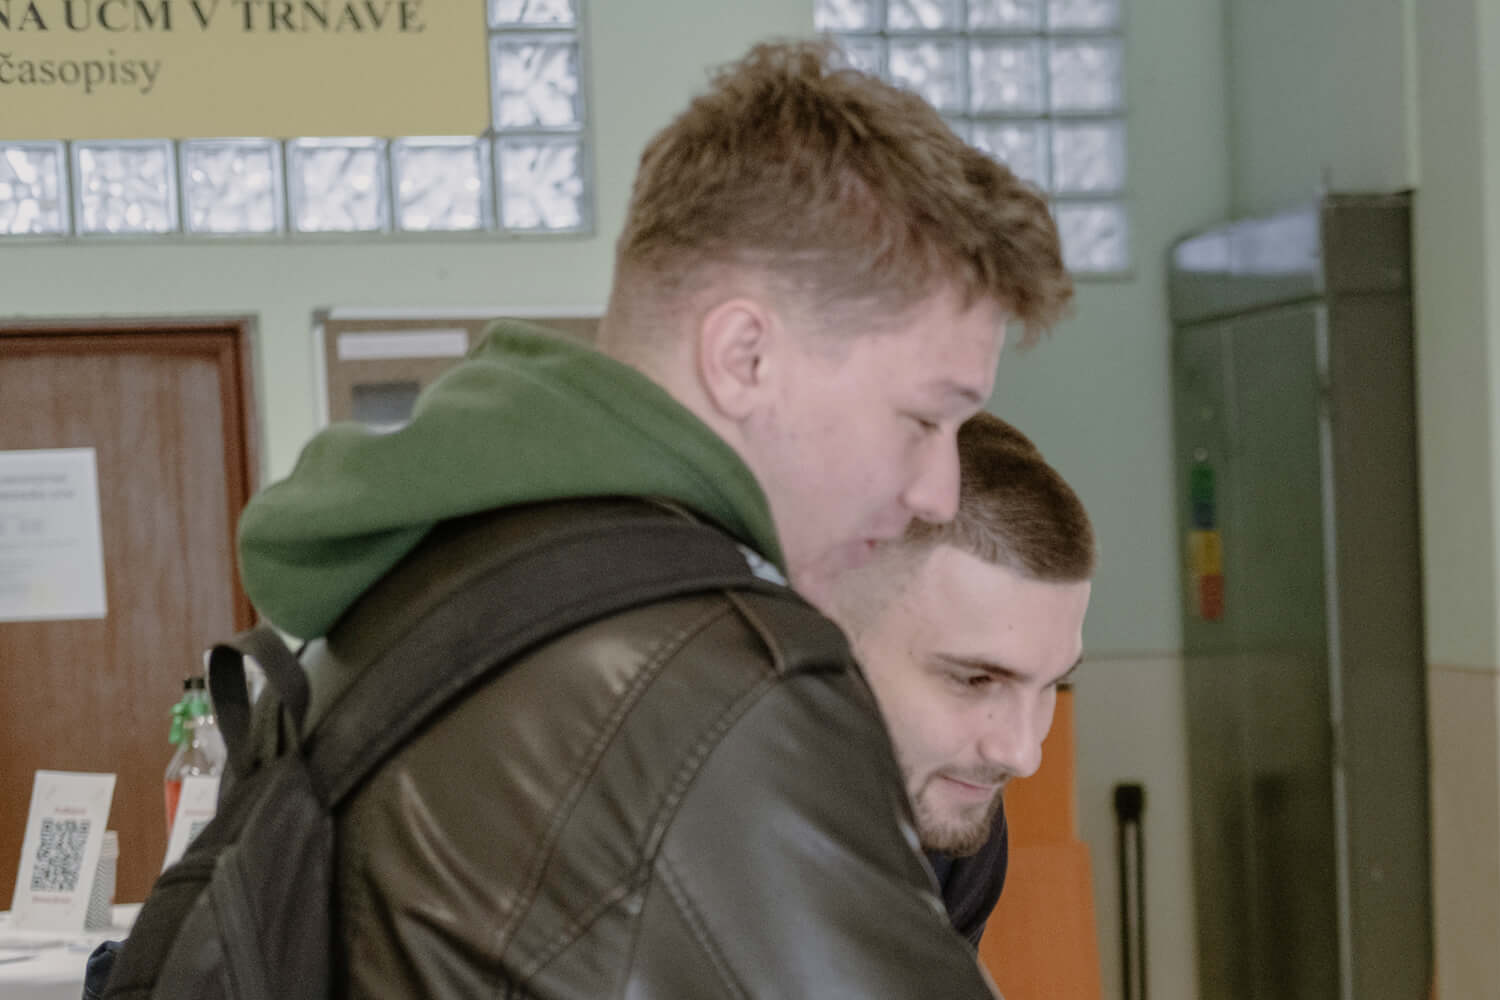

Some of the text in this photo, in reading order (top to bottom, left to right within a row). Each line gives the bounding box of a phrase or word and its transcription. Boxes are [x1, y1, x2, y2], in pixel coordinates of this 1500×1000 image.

[63, 0, 173, 32] UCM
[188, 0, 219, 30] V
[233, 0, 426, 33] TRNAVE
[0, 49, 162, 95] časopisy
